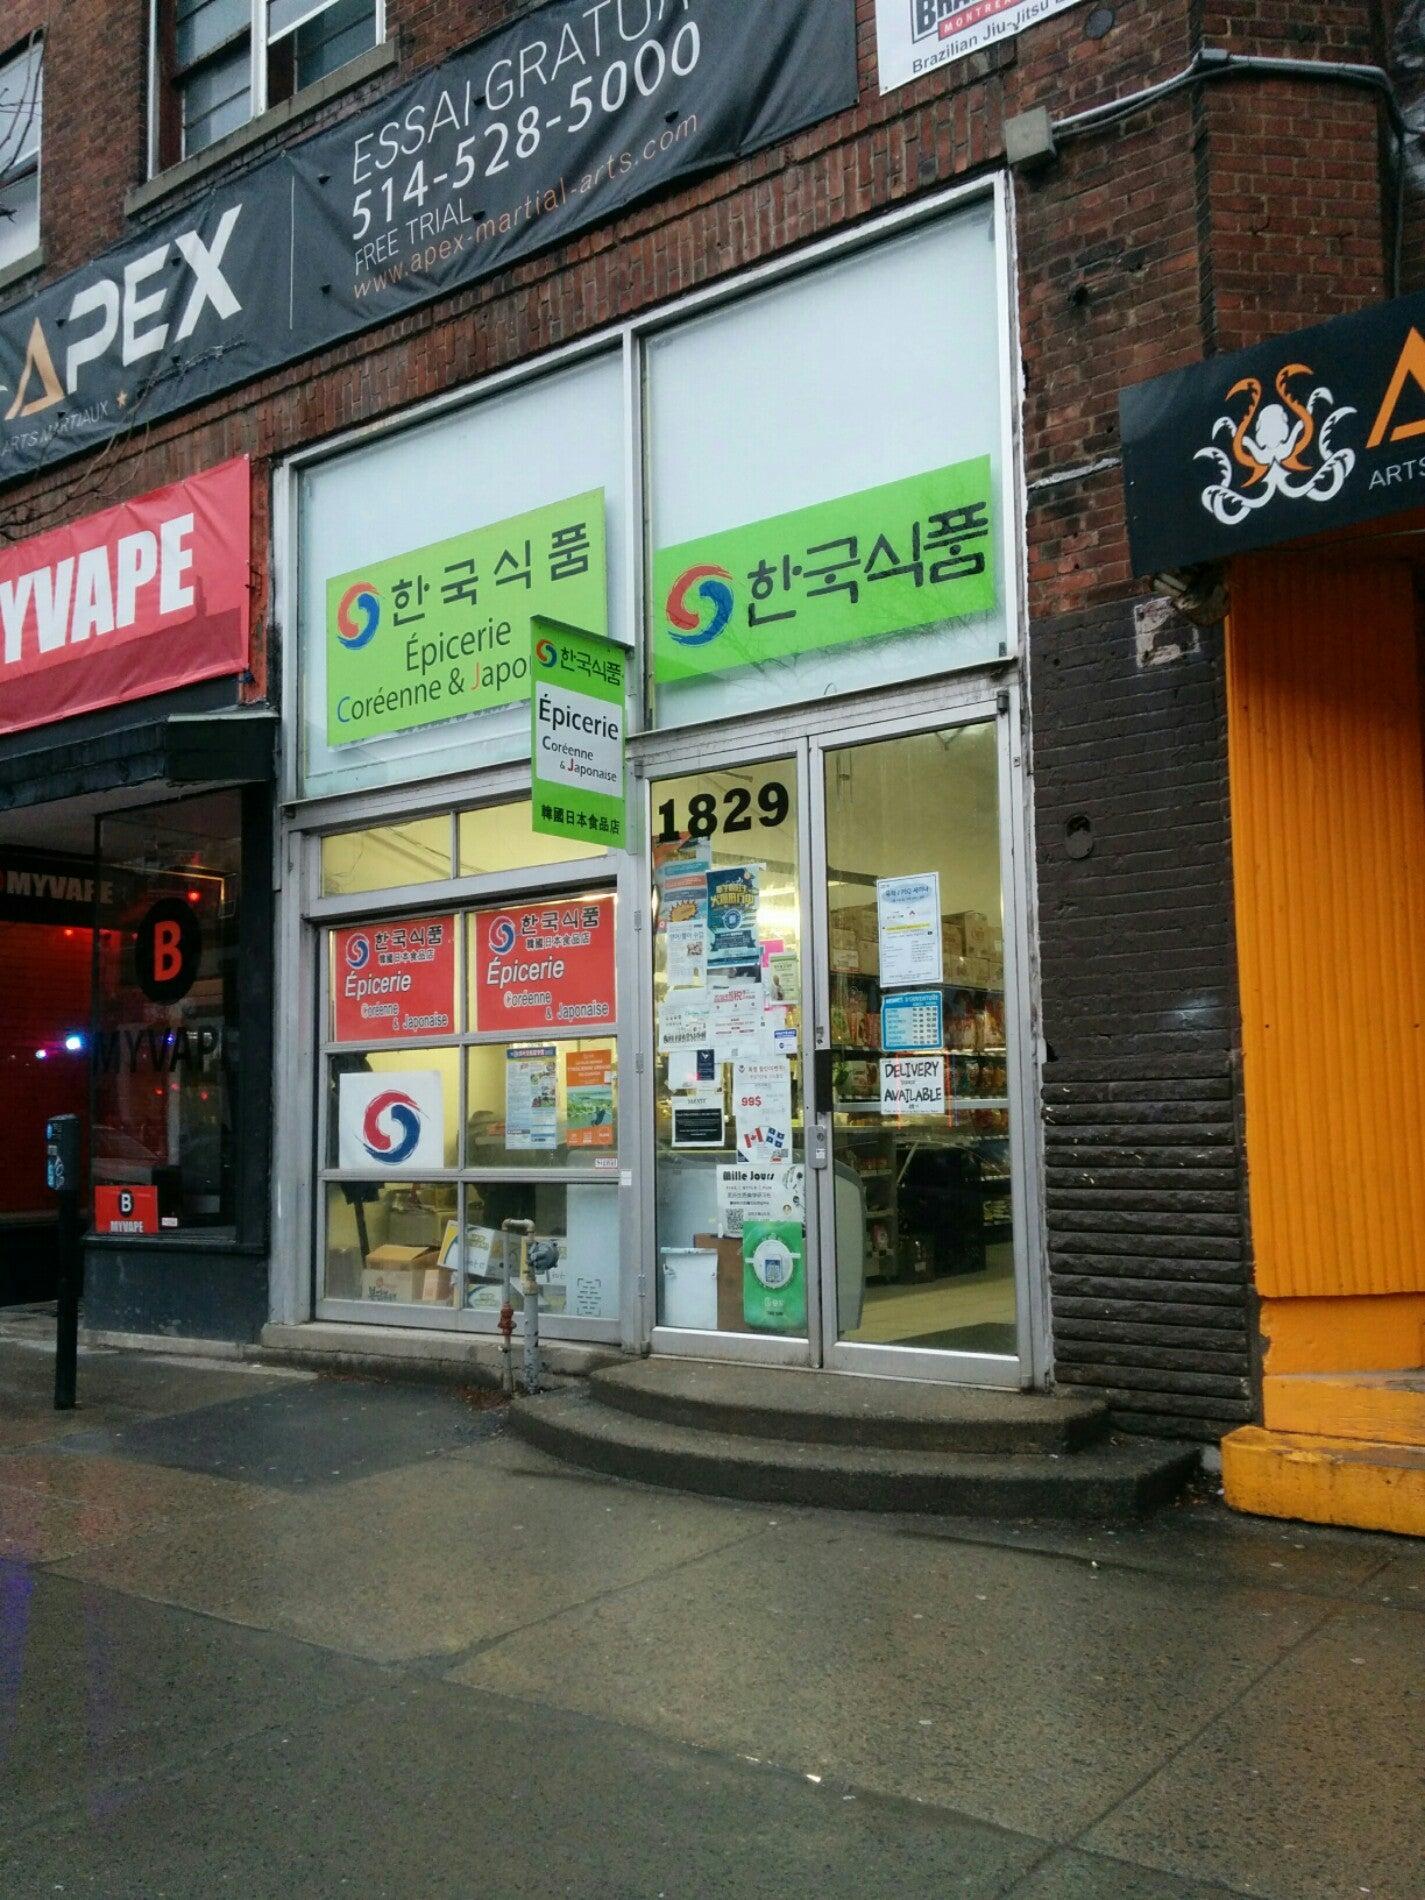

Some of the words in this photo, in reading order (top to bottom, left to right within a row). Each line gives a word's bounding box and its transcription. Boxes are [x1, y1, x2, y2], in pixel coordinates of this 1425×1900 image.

[912, 35, 978, 74] Brazilian
[982, 3, 1050, 41] Jiu-Jitsu
[353, 81, 471, 184] ESSAI
[485, 0, 692, 111] GRATU
[352, 21, 700, 240] 514-528-5000
[353, 112, 697, 299] www.apex-martial-arts.com
[355, 229, 399, 276] FREE
[405, 197, 472, 245] TRIAL
[5, 203, 243, 421] APEX
[747, 501, 990, 628] 한국식품
[405, 617, 513, 675] Épicerie
[560, 646, 622, 687] 한국식품
[336, 679, 442, 723] Coréenne
[447, 667, 465, 695] &
[469, 656, 532, 691] Japo
[539, 693, 619, 741] Épicerie
[542, 735, 594, 762] Coréenne
[567, 758, 617, 783] Japonaise
[659, 781, 790, 843] 1829
[374, 924, 443, 951] 한국식품
[520, 906, 600, 936] 한국식품
[154, 920, 183, 982] B
[345, 971, 412, 1001] Épicerie
[487, 956, 565, 989] Épicerie
[503, 991, 551, 1009] Coréenne
[557, 1000, 610, 1023] Japonaise
[402, 1011, 449, 1032] Japonaise
[884, 1061, 940, 1078] DELIVERY
[883, 1086, 942, 1103] AVAILABLE
[722, 1170, 748, 1182] Mille
[750, 1170, 775, 1181] Jours
[121, 1193, 132, 1212] B
